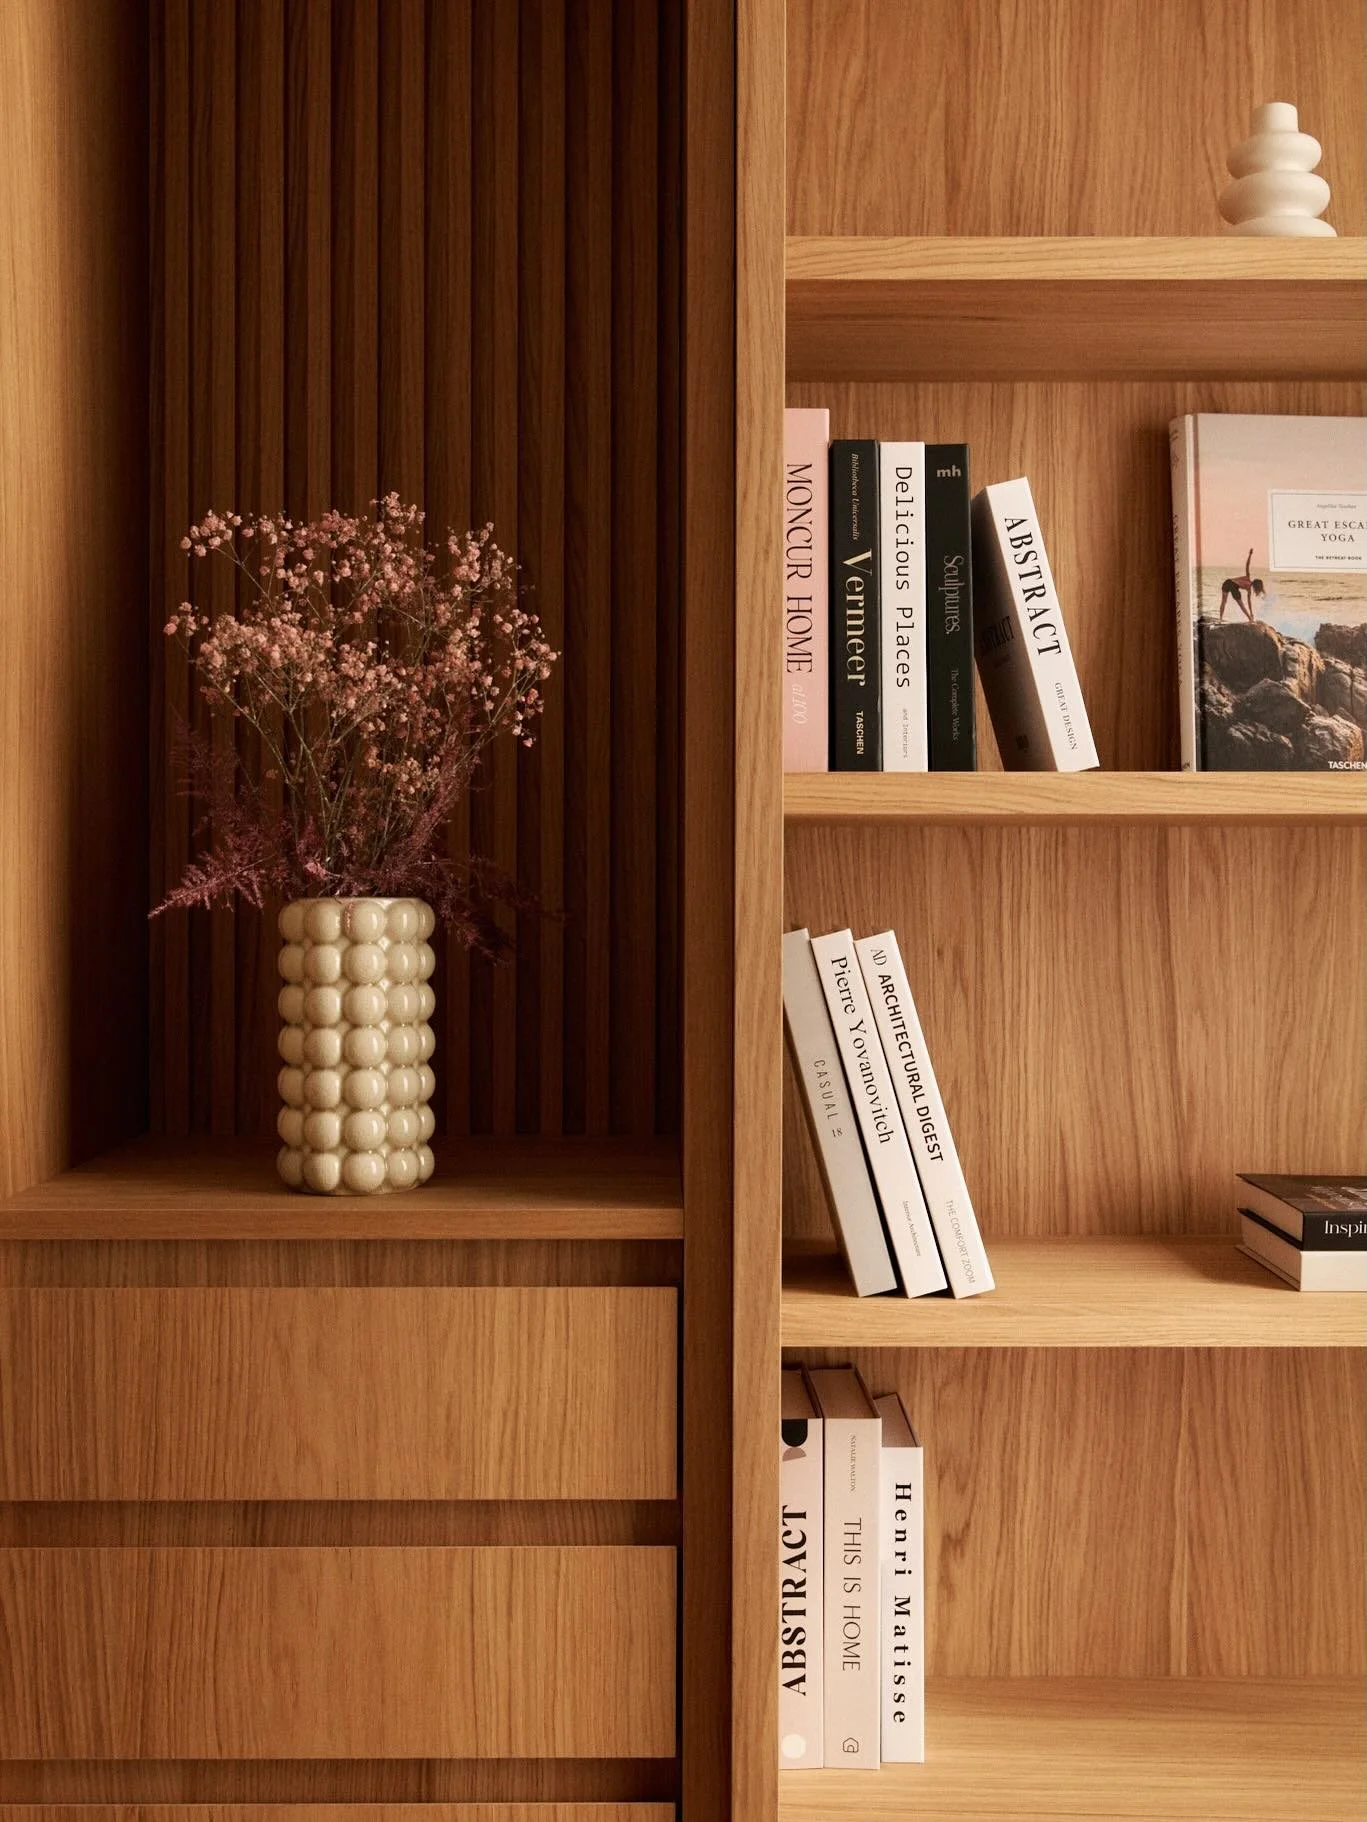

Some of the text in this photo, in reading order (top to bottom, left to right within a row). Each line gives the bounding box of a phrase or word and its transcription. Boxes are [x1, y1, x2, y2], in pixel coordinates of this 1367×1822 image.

[936, 465, 962, 478] mh
[1288, 520, 1367, 530] GREAT ESCA
[1320, 533, 1355, 543] YOGA
[786, 463, 813, 673] MONCUR HOME
[842, 548, 873, 687] Vermeer
[895, 467, 915, 688] Delicious Places
[1004, 518, 1062, 655] ABSTRACT
[855, 710, 864, 755] TASCHEN
[1055, 682, 1078, 750] GREAT DESIGN
[814, 1059, 838, 1120] CASUAL
[831, 955, 895, 1144] Pierre Yovanovitch
[878, 973, 924, 1103] ARCHITECTURAL
[916, 1105, 944, 1162] DIGEST
[945, 1199, 957, 1217] THE
[950, 1216, 969, 1257] COMFORT
[781, 1504, 807, 1697] ABSTRACT
[842, 1517, 862, 1671] THIS IS HOME
[893, 1482, 912, 1723] Henri Matisse
